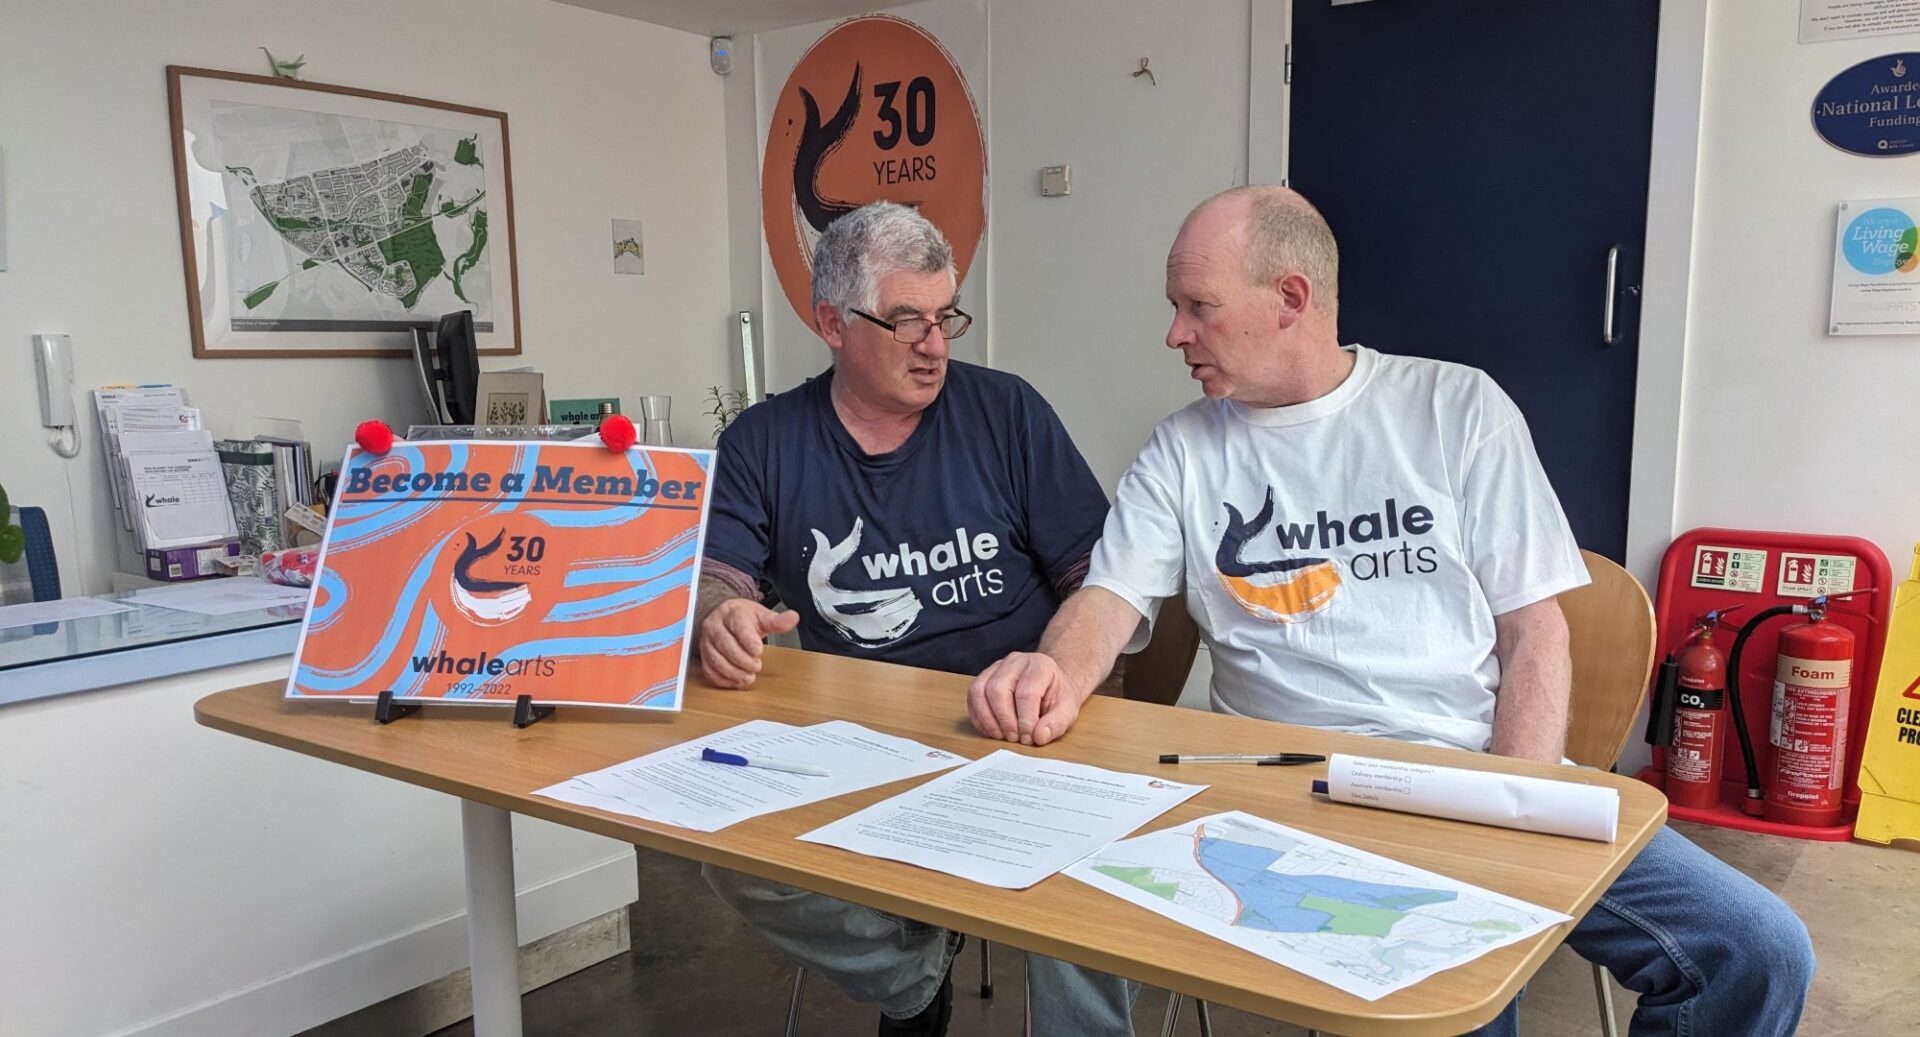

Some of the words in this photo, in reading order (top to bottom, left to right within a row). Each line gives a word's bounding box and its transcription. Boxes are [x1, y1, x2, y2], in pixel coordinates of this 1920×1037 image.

[1871, 81, 1920, 95] Awarde
[873, 75, 936, 151] 30
[1822, 96, 1898, 117] National
[873, 154, 936, 186] YEARS
[1852, 226, 1905, 242] Living
[1862, 240, 1909, 257] Wage
[560, 411, 589, 421] whale
[345, 468, 491, 495] Become
[499, 472, 525, 493] a
[532, 465, 702, 500] Member
[1275, 498, 1435, 550] whale
[506, 535, 546, 562] 30
[861, 526, 1000, 580] whale
[1350, 540, 1439, 581] arts
[504, 564, 542, 576] YEARS
[931, 565, 1005, 606] arts
[1792, 666, 1835, 680] Foam
[1896, 707, 1920, 727] CLE
